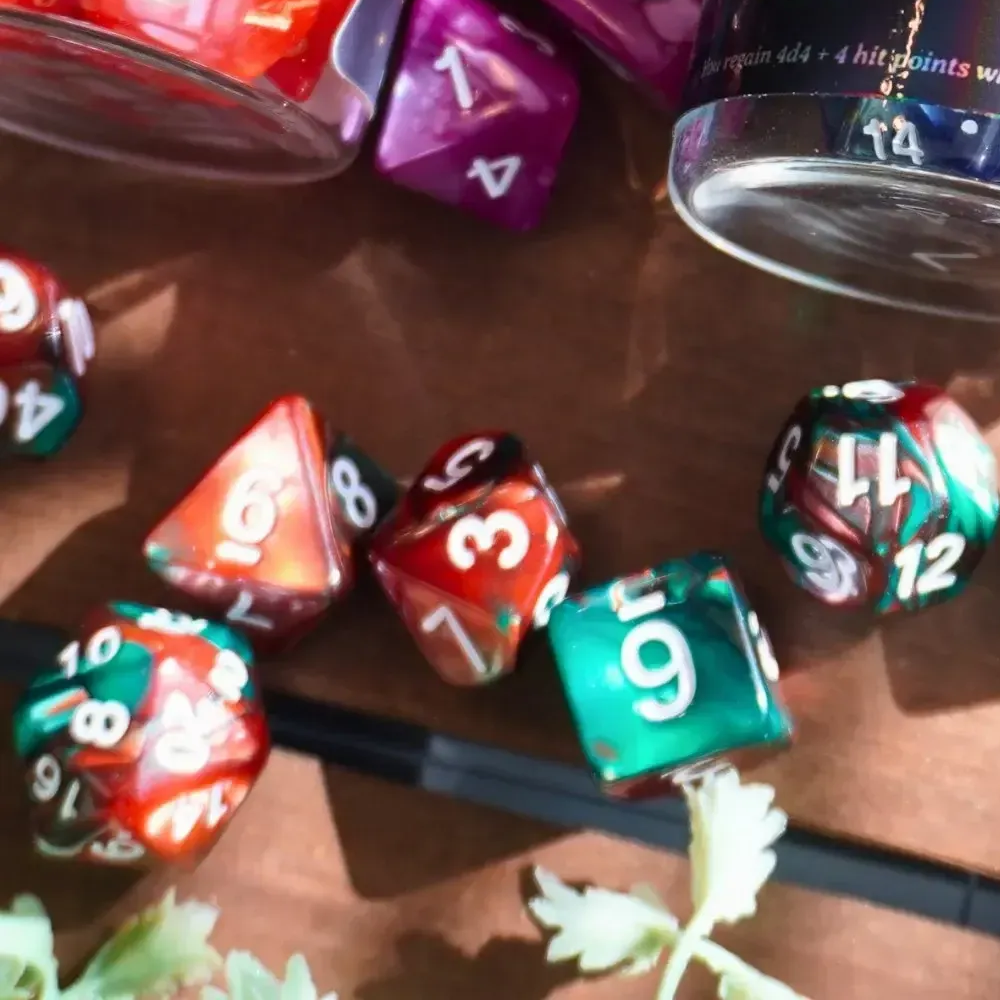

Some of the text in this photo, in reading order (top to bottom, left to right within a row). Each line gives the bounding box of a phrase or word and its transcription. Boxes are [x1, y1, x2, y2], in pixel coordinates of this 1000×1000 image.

[433, 46, 475, 110] 1
[722, 46, 771, 73] regain
[777, 41, 811, 65] 4d4
[834, 46, 849, 65] 4
[852, 41, 886, 68] hit
[892, 49, 971, 79] points
[467, 155, 523, 198] 4
[332, 456, 377, 529] 8
[836, 432, 912, 507] 11
[447, 509, 531, 570] 3
[895, 531, 966, 606] 12
[58, 624, 122, 680] 10
[421, 604, 487, 673] 7
[70, 698, 131, 749] 8
